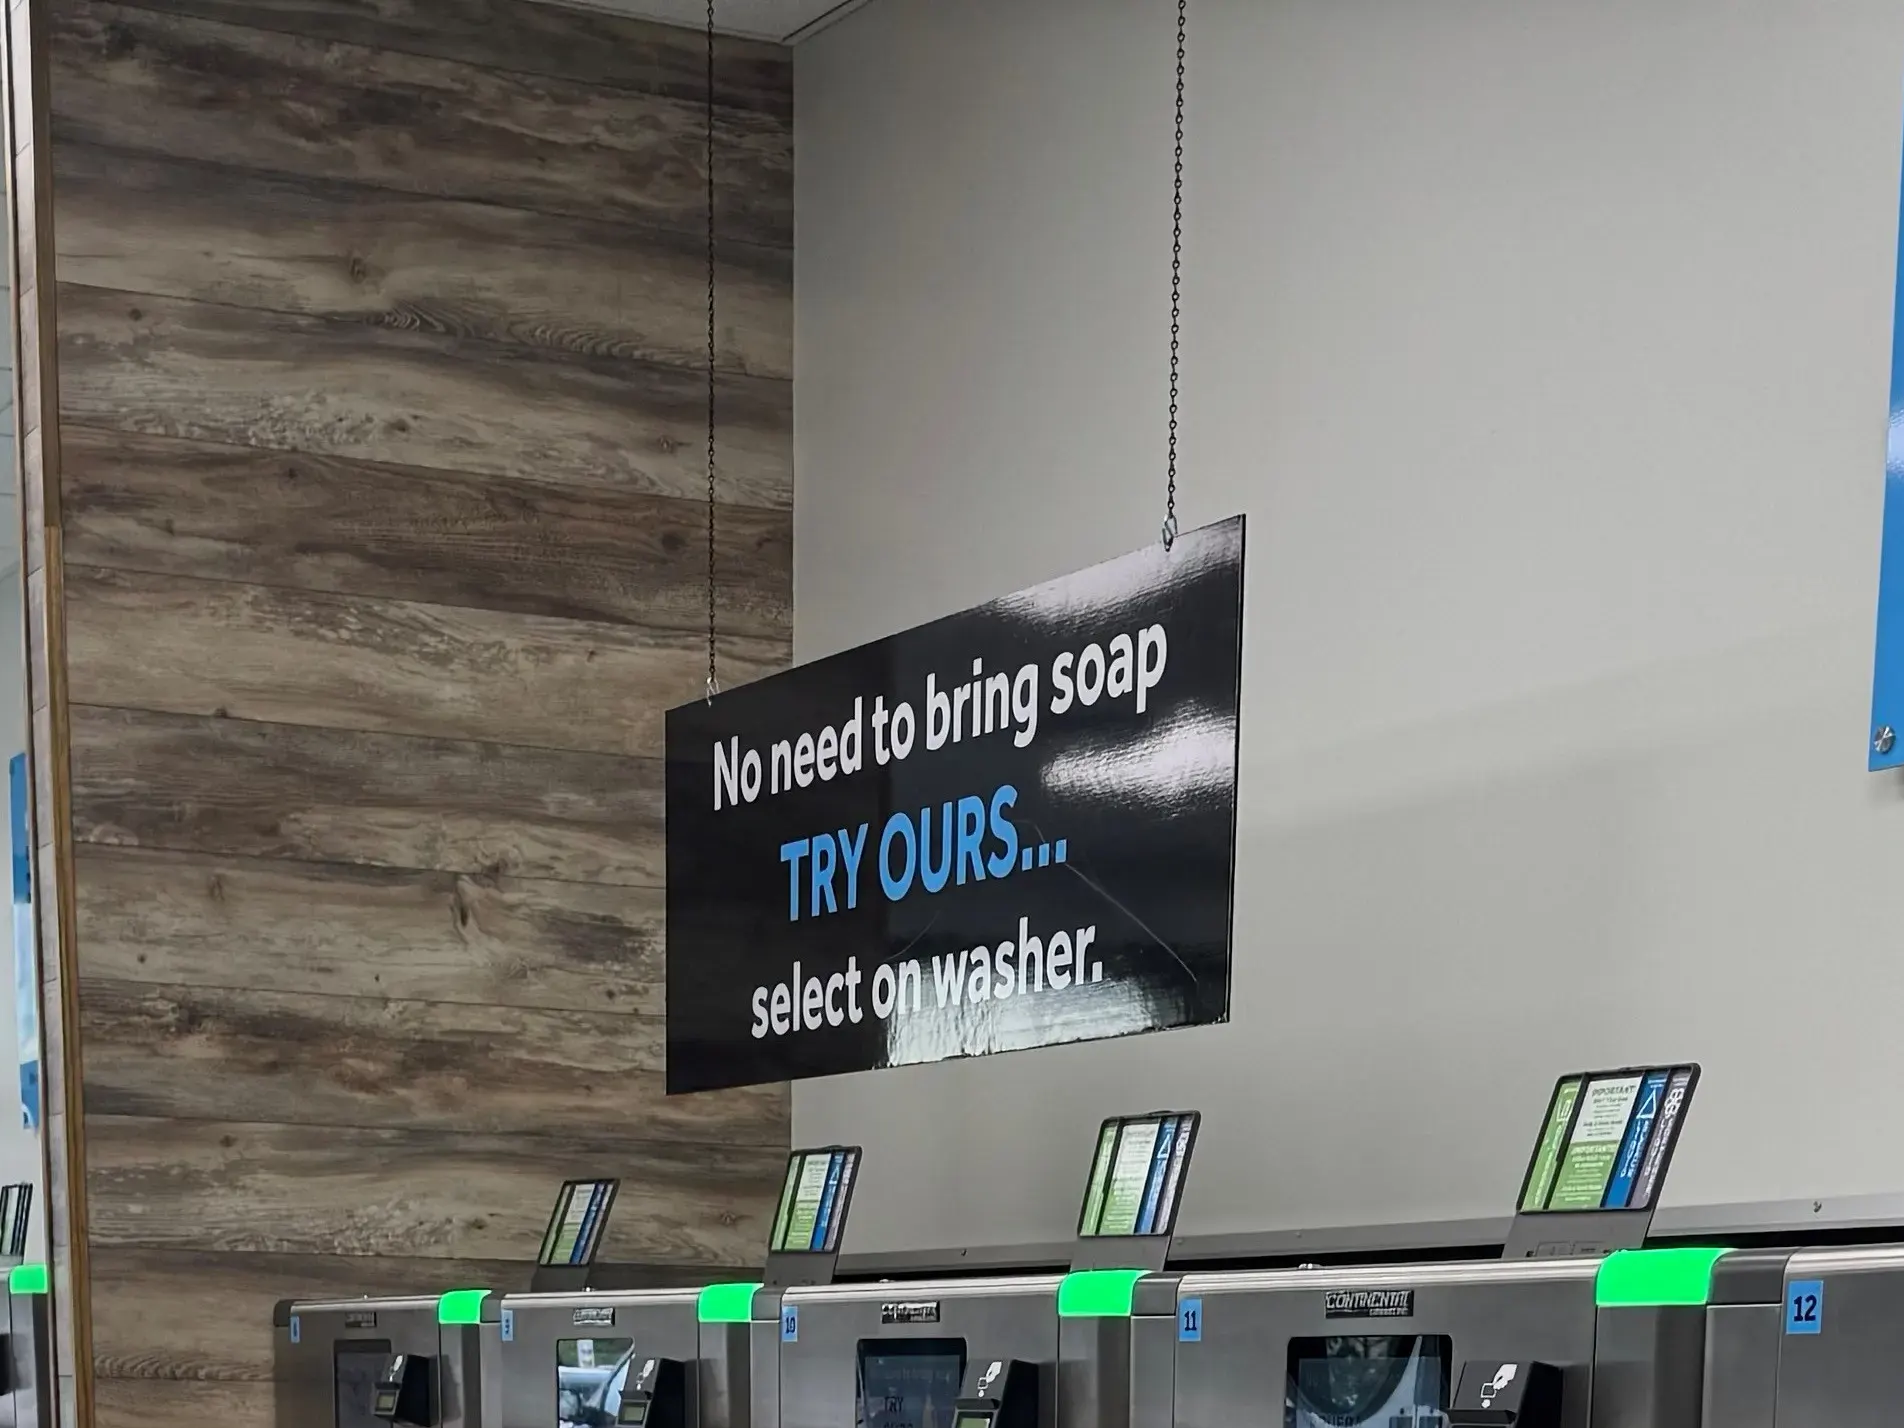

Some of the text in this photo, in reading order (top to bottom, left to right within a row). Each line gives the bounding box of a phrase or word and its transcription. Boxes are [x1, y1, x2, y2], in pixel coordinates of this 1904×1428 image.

[713, 623, 1168, 812] No need to bring soap
[780, 783, 1069, 923] TRY OURS...
[750, 916, 1104, 1040] select on washer.
[1184, 1310, 1197, 1331] 11
[1793, 1294, 1817, 1322] 12
